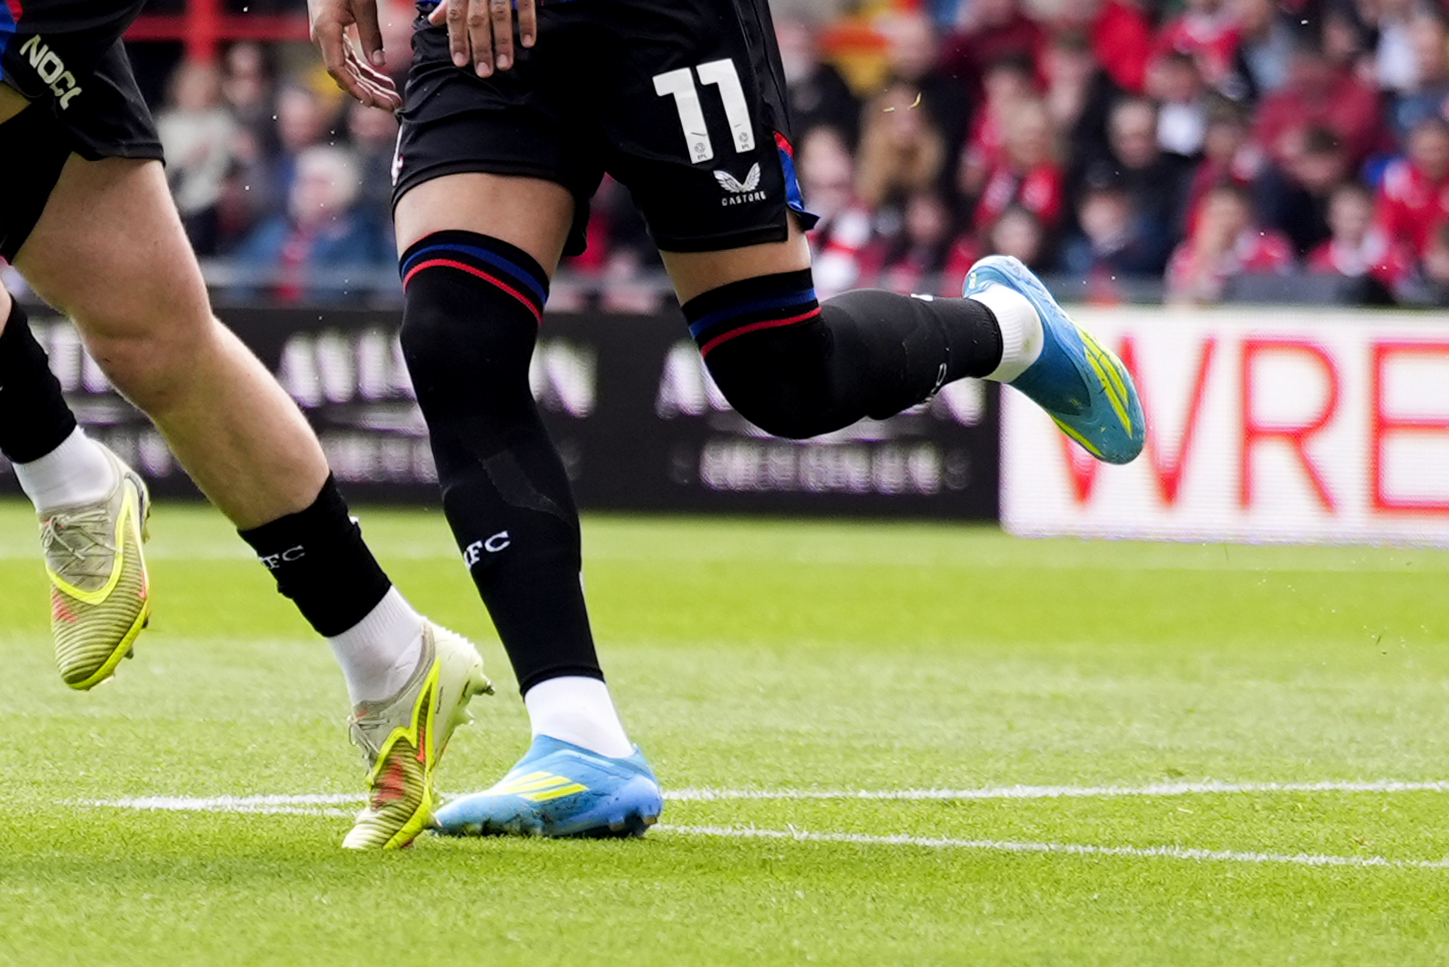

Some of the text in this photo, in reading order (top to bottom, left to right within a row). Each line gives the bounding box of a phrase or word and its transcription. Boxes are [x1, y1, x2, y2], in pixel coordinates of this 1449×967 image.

[652, 58, 756, 164] 11
[721, 191, 767, 207] CASTORE
[258, 545, 305, 569] FC
